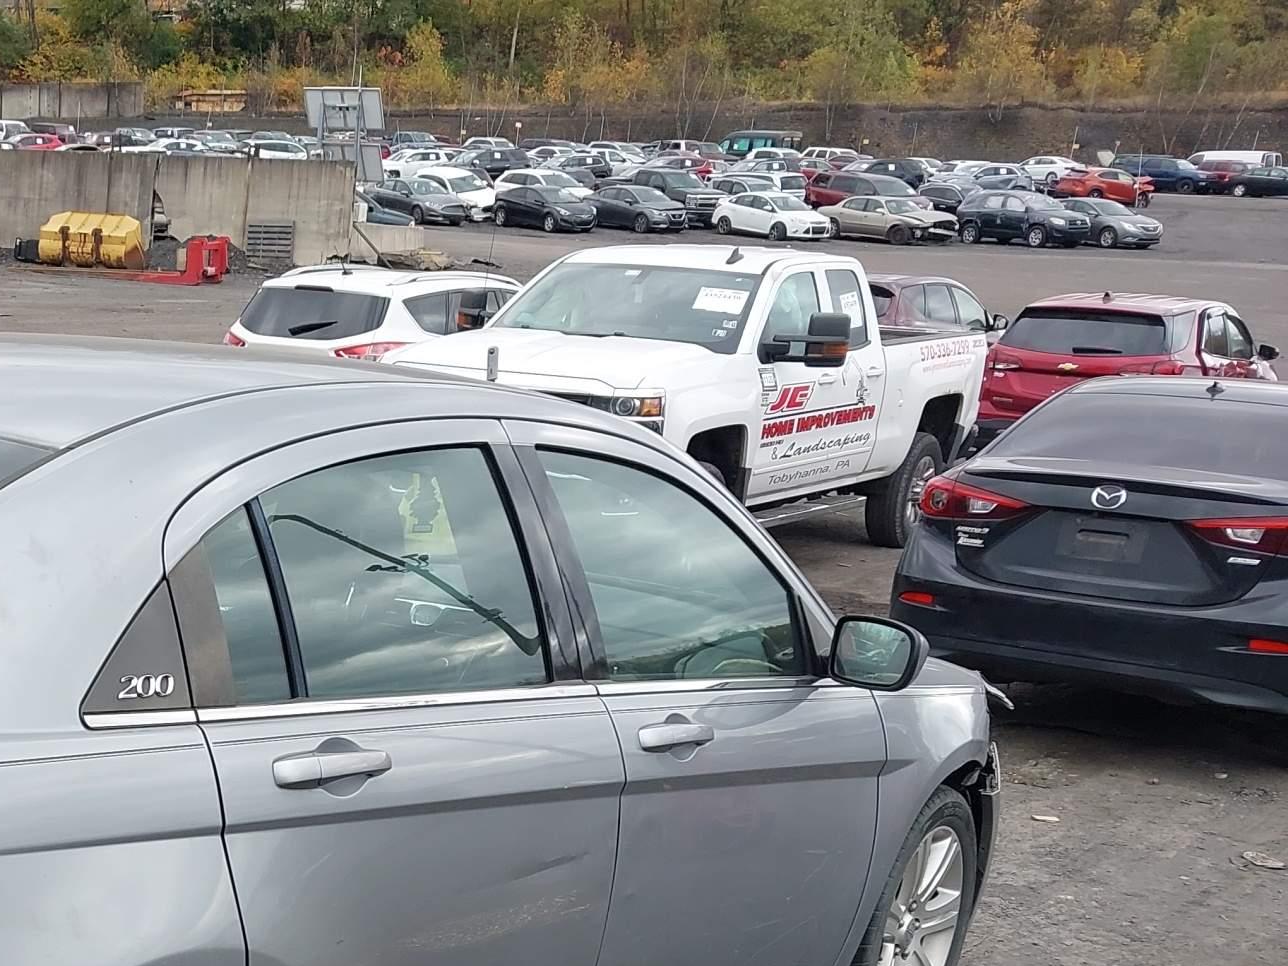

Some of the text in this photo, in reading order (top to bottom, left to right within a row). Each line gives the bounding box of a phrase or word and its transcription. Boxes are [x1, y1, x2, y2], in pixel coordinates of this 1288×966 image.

[919, 340, 970, 362] 570-336-7299
[768, 384, 812, 412] JE
[760, 404, 876, 440] HOME IMPROVEMENTS
[771, 432, 872, 460] & Landscaping
[835, 459, 850, 470] PA
[118, 673, 175, 700] 200
